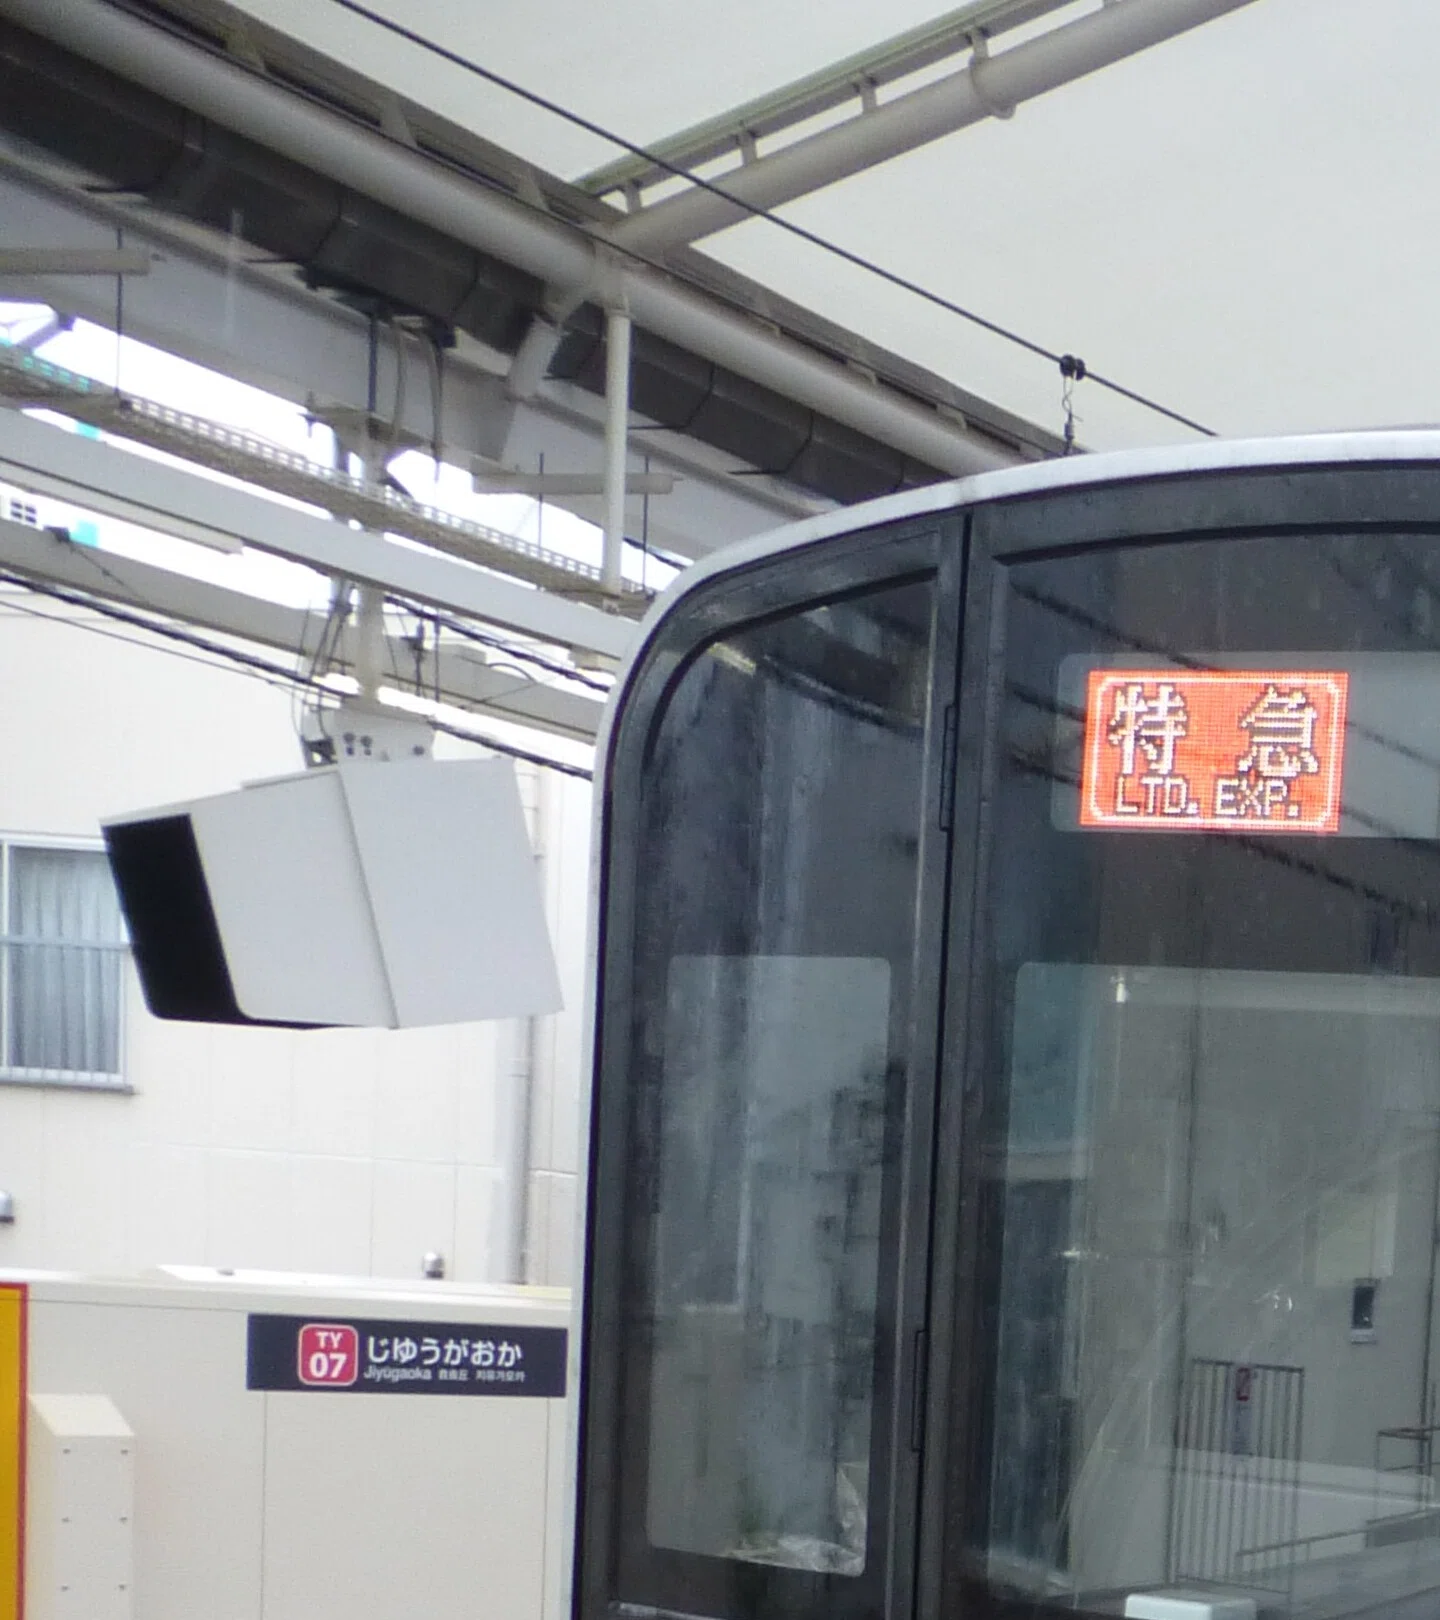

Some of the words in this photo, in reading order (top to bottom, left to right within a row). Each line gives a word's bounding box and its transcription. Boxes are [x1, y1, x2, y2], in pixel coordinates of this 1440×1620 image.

[1107, 683, 1319, 778] 特急
[1114, 775, 1200, 815] LTD.
[1213, 777, 1300, 818] EXP.
[316, 1331, 343, 1349] TY
[366, 1336, 523, 1367] じゆうがおか
[309, 1352, 348, 1379] 07
